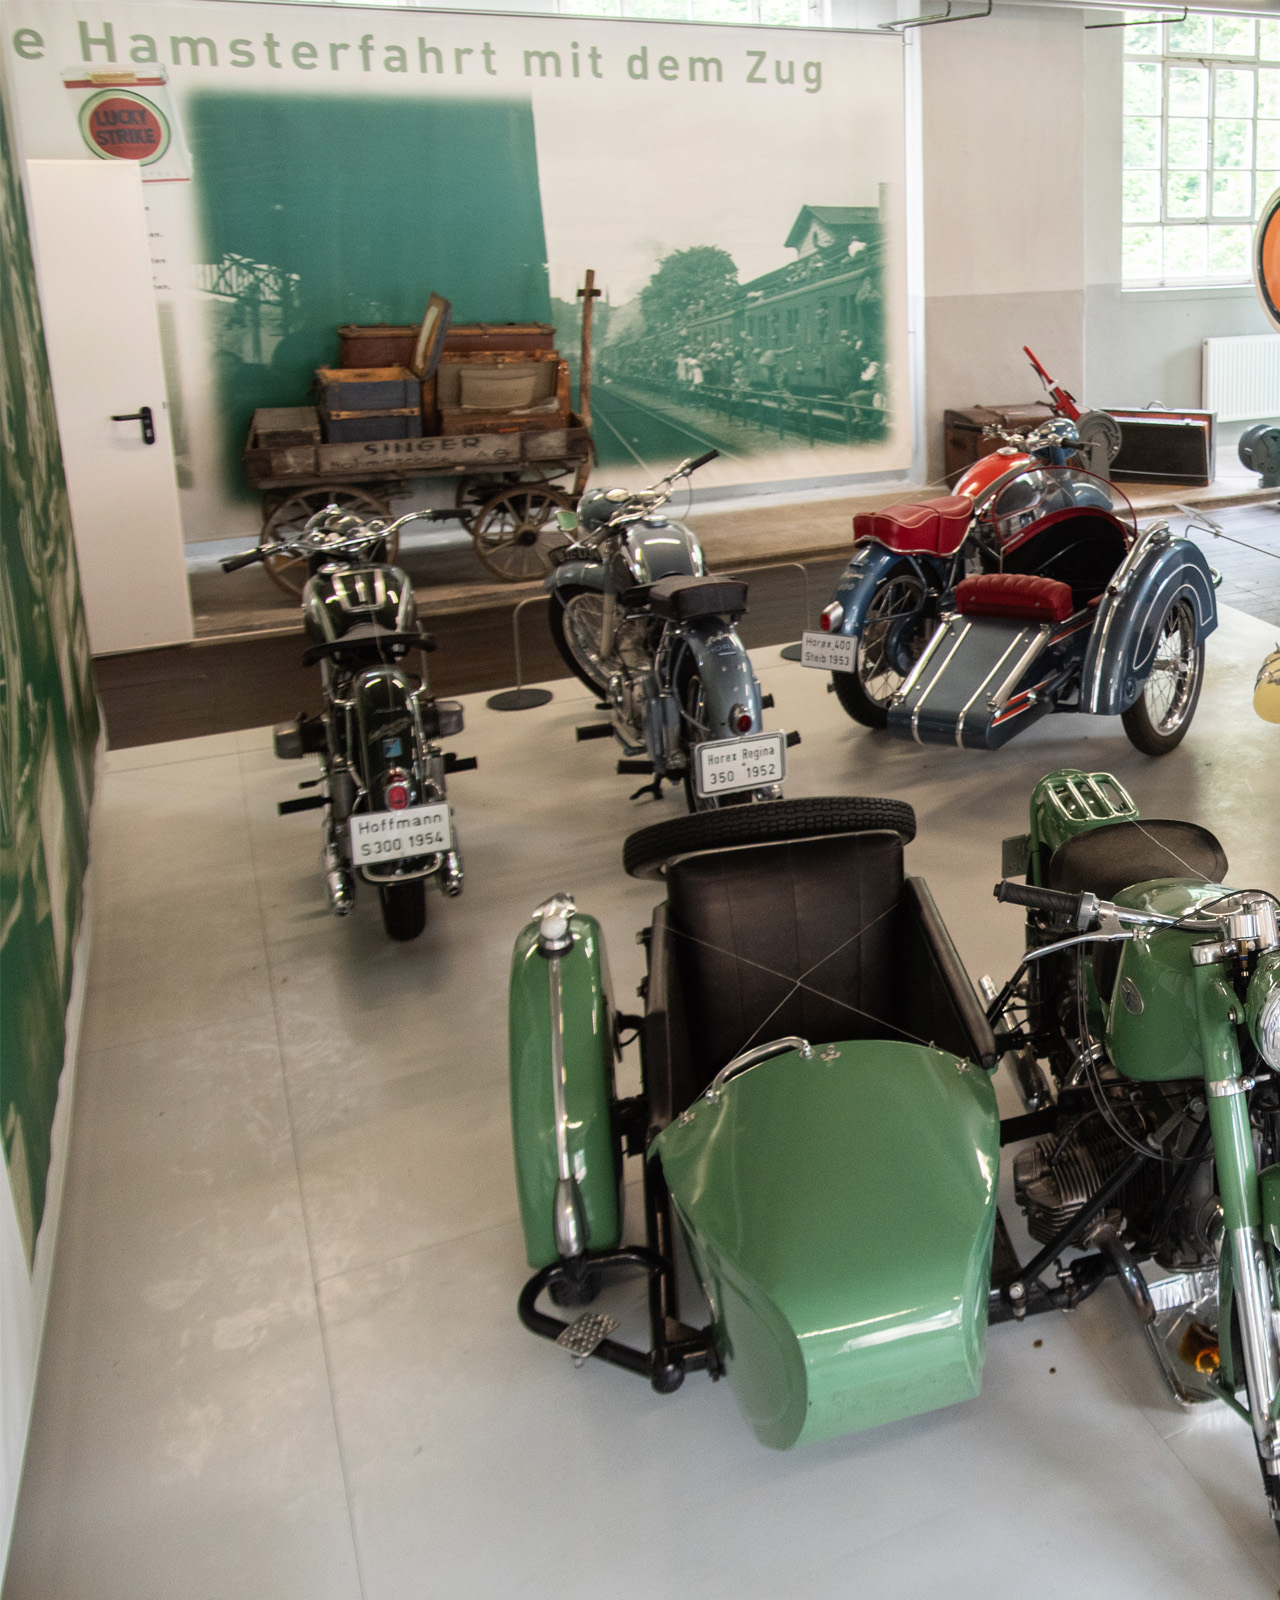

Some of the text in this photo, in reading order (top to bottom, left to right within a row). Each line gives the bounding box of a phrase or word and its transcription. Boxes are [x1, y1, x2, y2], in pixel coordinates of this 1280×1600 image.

[77, 20, 497, 76] Hamsterfahrt
[523, 41, 603, 78] mit
[627, 46, 723, 82] dem
[746, 50, 822, 94] Zug
[95, 108, 147, 127] LUCKY
[95, 128, 156, 146] STRIKE
[363, 437, 481, 456] SINGER
[806, 636, 851, 651] Horex 400
[805, 651, 850, 666] Steib 1953
[708, 746, 775, 766] Horex Regina
[710, 763, 776, 785] 350 1952
[358, 813, 442, 835] Hoffmann
[408, 831, 443, 848] 1954
